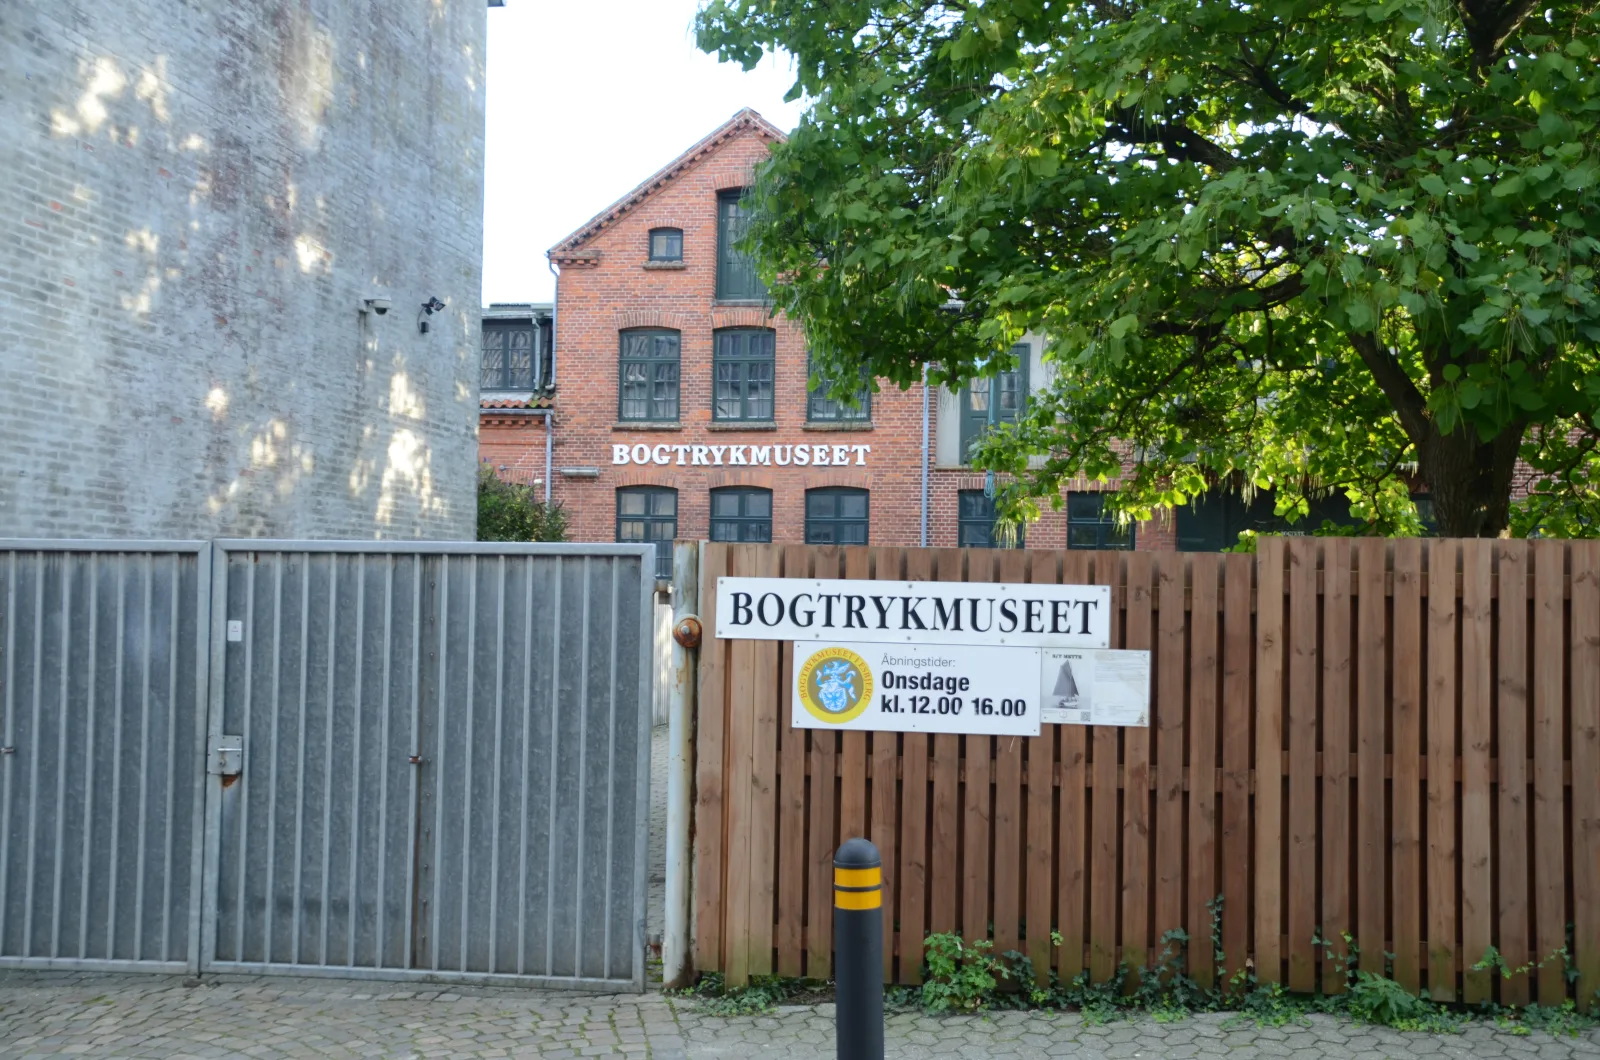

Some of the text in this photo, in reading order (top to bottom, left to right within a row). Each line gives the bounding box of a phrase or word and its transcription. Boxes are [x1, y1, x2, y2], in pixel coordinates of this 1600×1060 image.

[612, 444, 871, 466] BOGTRYKMUSEET
[730, 592, 1098, 634] BOGTRYKMUSEET
[881, 653, 956, 668] Åbningstider:
[800, 648, 855, 699] BOGTRYKMUSEET
[881, 670, 970, 695] Onsdage
[971, 698, 1026, 717] 16.00
